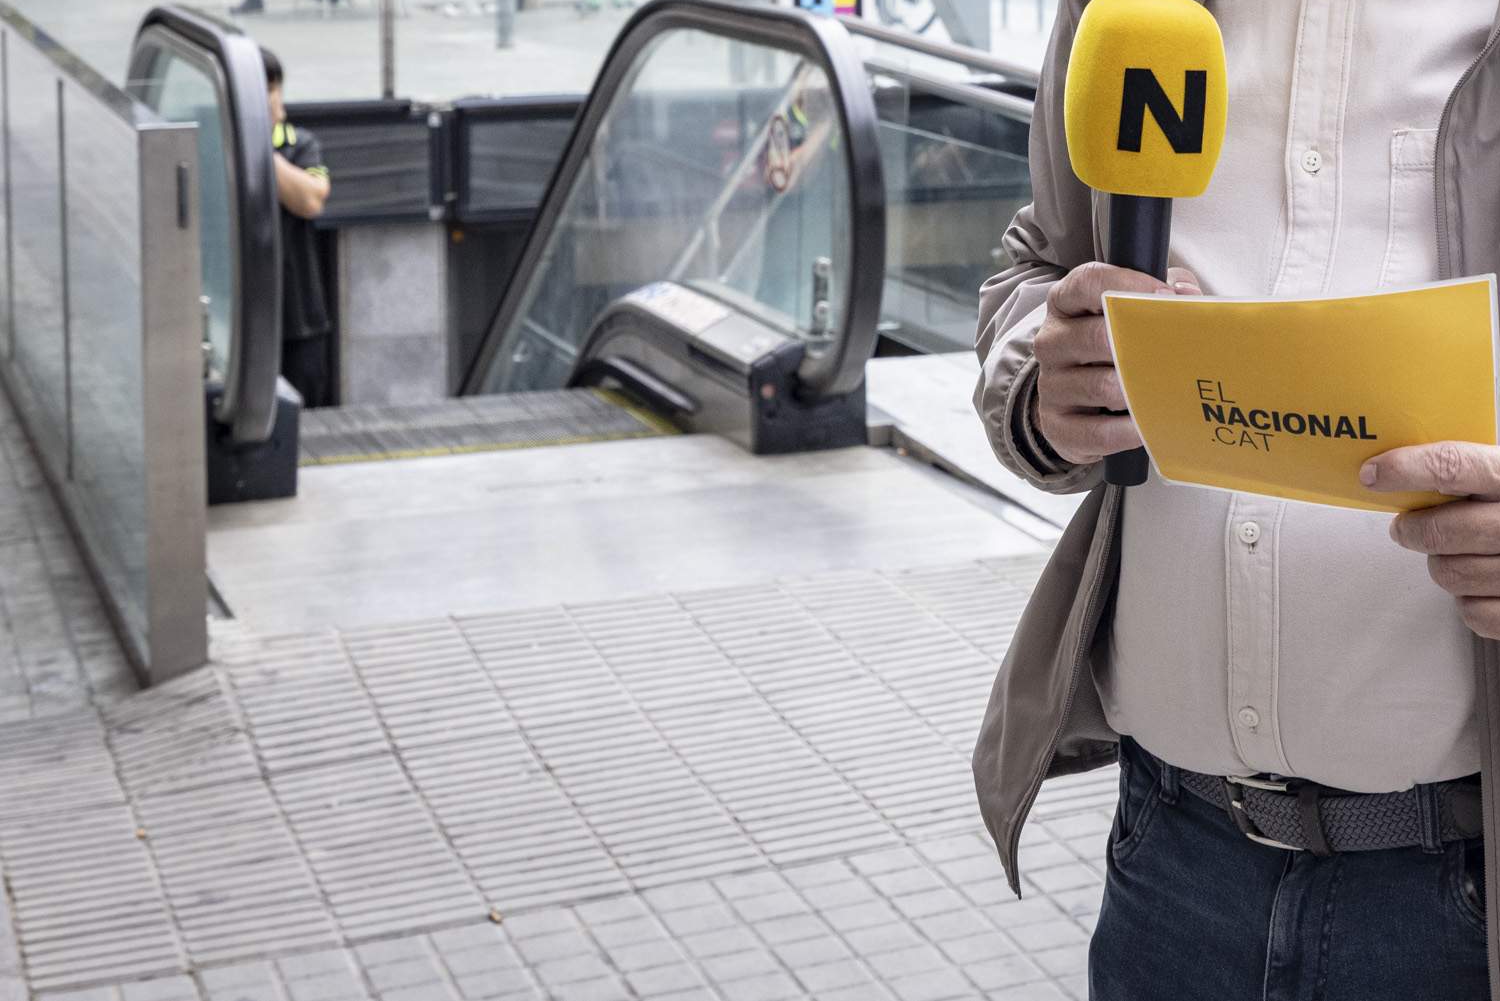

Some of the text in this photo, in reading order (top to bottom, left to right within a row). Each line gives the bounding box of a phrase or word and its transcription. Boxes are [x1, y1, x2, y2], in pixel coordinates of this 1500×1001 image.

[1117, 68, 1207, 154] N
[1196, 379, 1236, 404] EL
[1203, 403, 1377, 440] NACIONAL
[1211, 427, 1274, 452] .CAT
